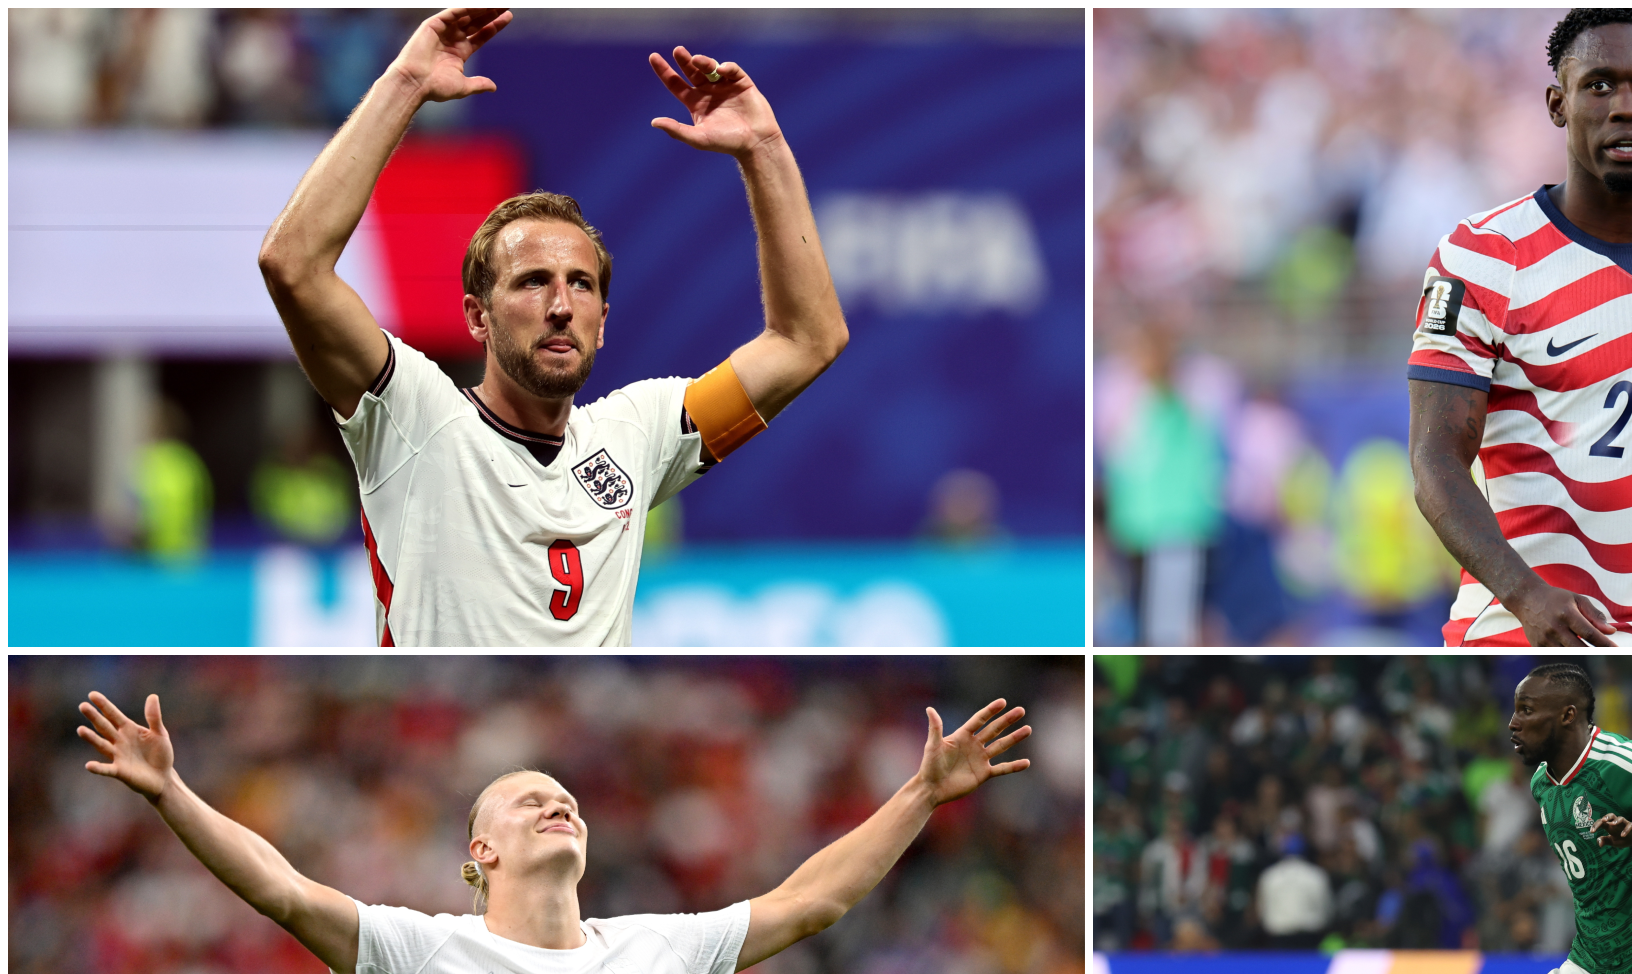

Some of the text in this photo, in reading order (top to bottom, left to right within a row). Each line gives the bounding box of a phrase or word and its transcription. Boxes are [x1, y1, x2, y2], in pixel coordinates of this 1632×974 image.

[1424, 322, 1446, 330] 2026
[548, 538, 584, 621] 9
[1554, 840, 1585, 880] 16
